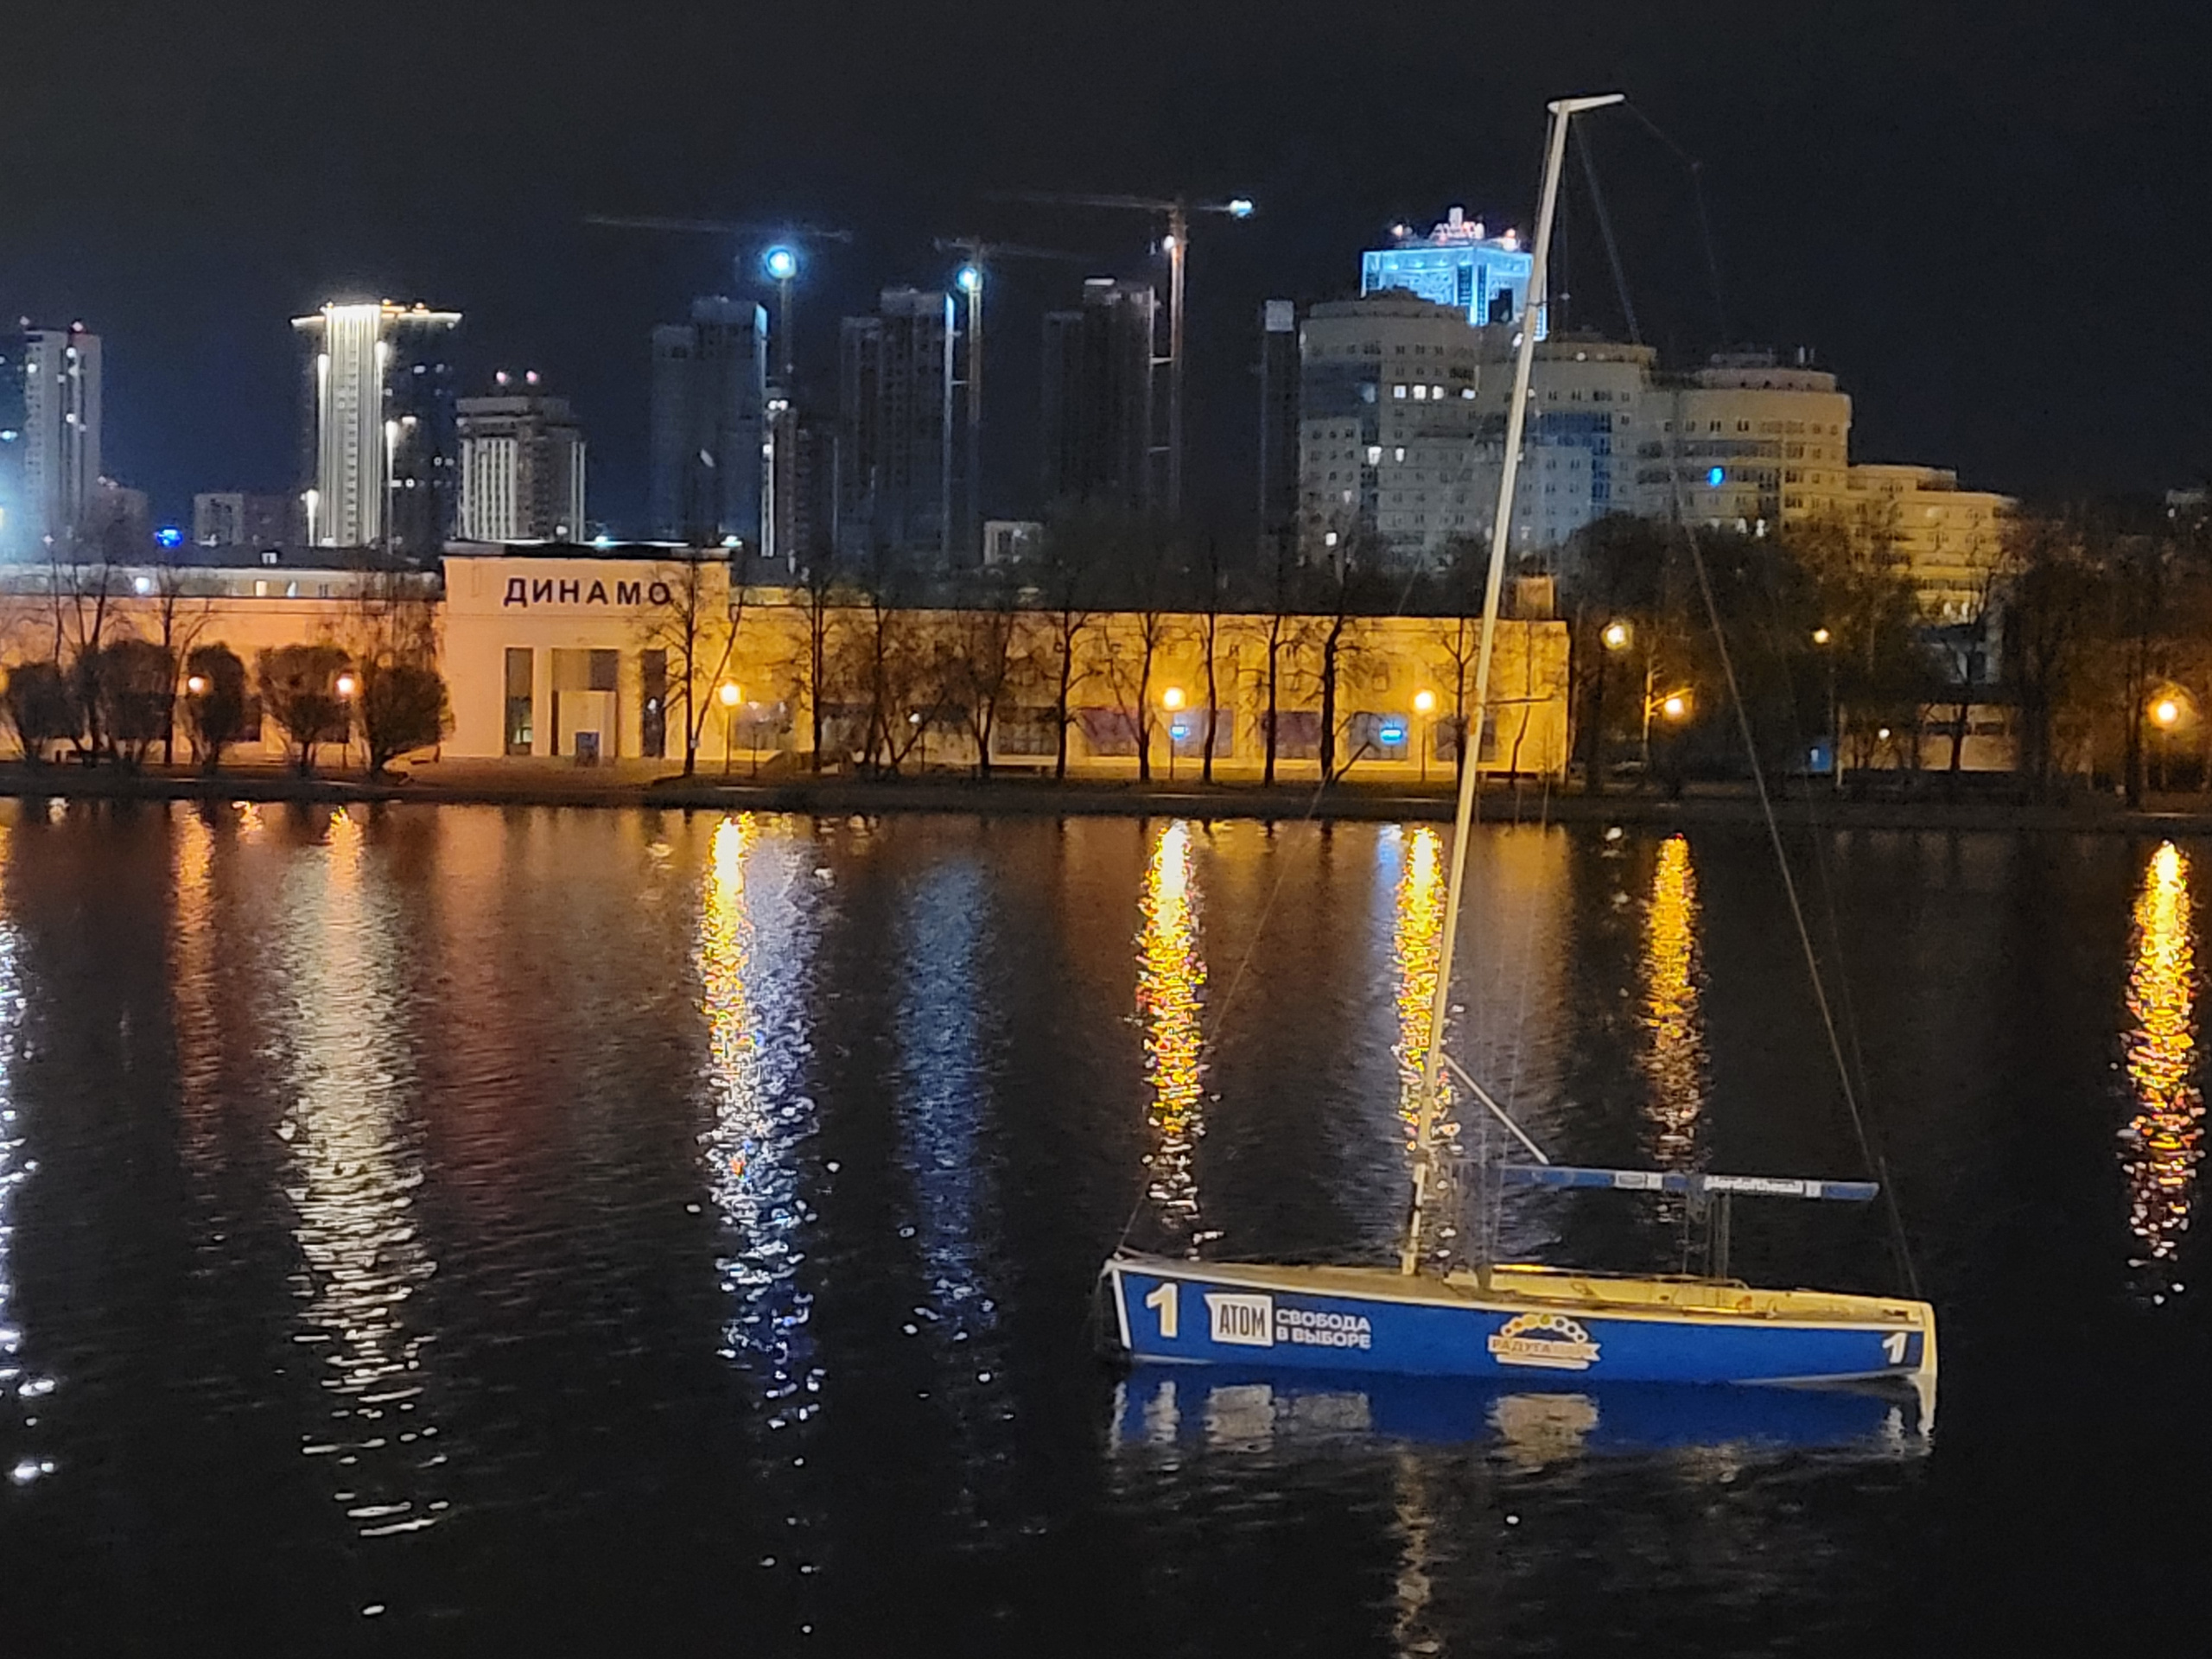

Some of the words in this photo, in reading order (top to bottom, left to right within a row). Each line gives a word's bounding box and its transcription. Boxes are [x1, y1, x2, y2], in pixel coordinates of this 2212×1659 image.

[503, 578, 671, 607] ДИНАМО
[1146, 1282, 1178, 1338] 1
[1219, 1304, 1267, 1338] АТОМ
[1276, 1309, 1371, 1332] СВОБОДА
[1276, 1325, 1290, 1342] В
[1291, 1327, 1371, 1350] ВЫБОРЕ
[1882, 1332, 1908, 1364] 1
